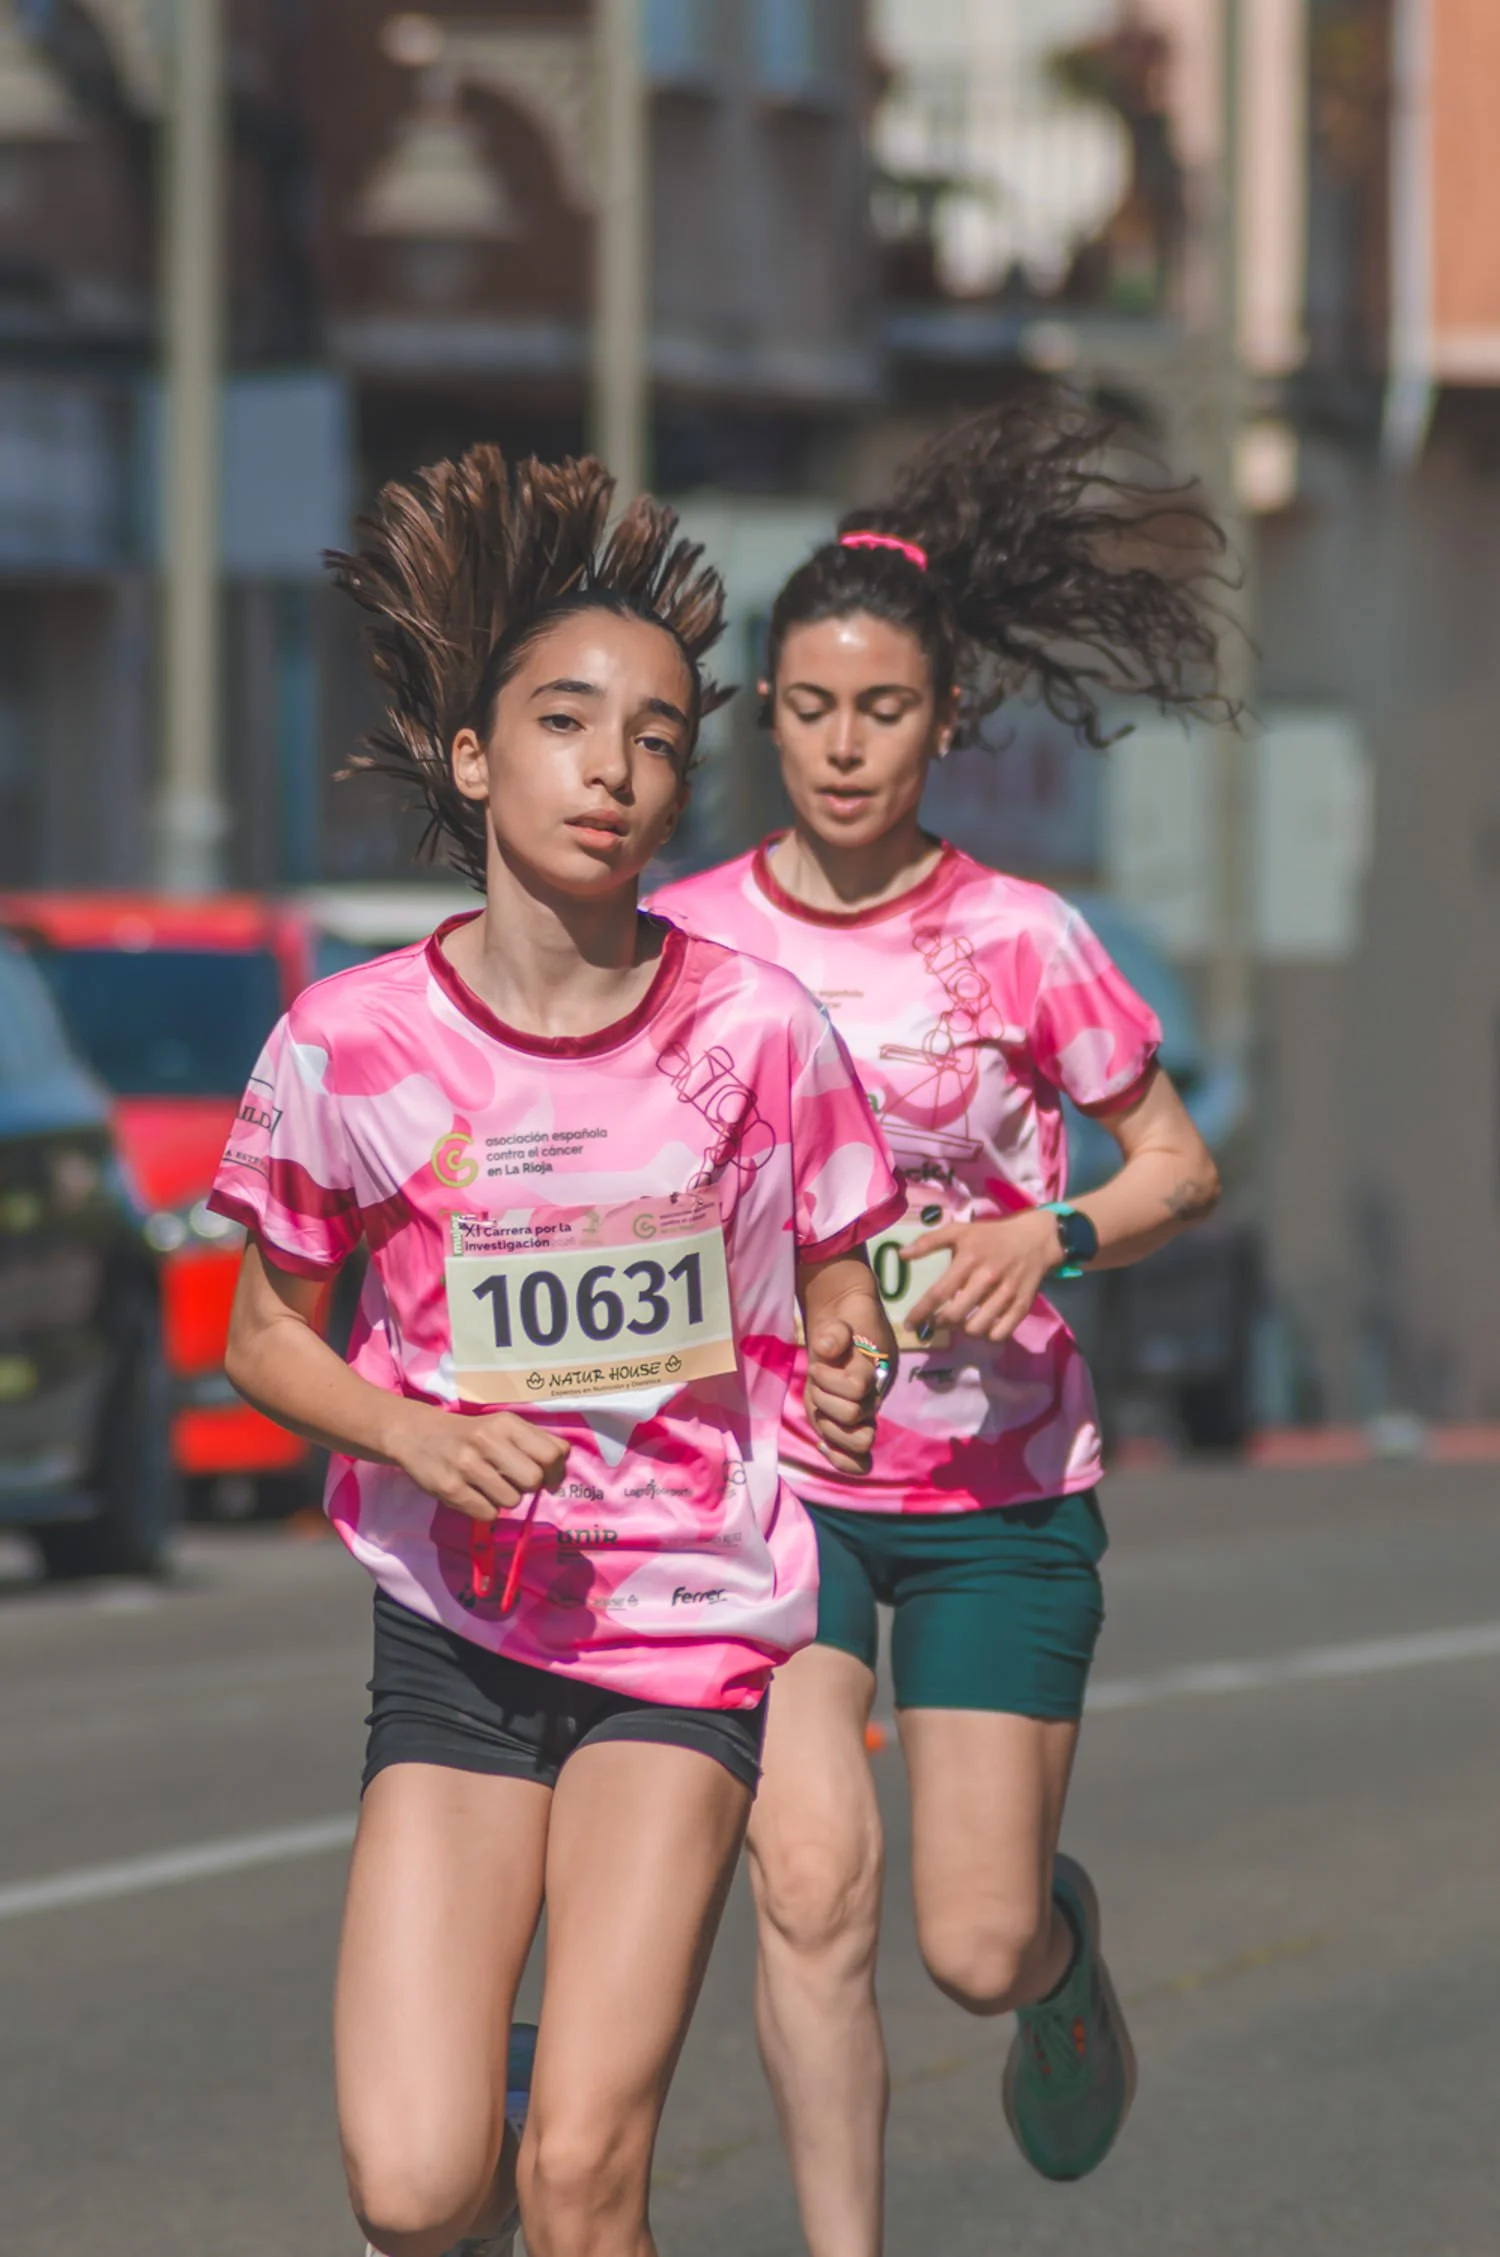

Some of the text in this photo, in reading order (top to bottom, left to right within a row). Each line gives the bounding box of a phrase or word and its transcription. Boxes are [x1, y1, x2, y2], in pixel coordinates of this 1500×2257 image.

[485, 1127, 608, 1147] asociación española
[486, 1144, 584, 1161] contra el cáncer
[487, 1160, 553, 1177] en La Rioja
[483, 1225, 532, 1237] Carrera
[535, 1224, 557, 1236] por
[559, 1222, 572, 1233] la
[465, 1237, 550, 1251] investigación
[472, 1252, 703, 1348] 10631
[548, 1361, 661, 1387] NATUR HOUSE
[569, 1483, 604, 1501] Rioja
